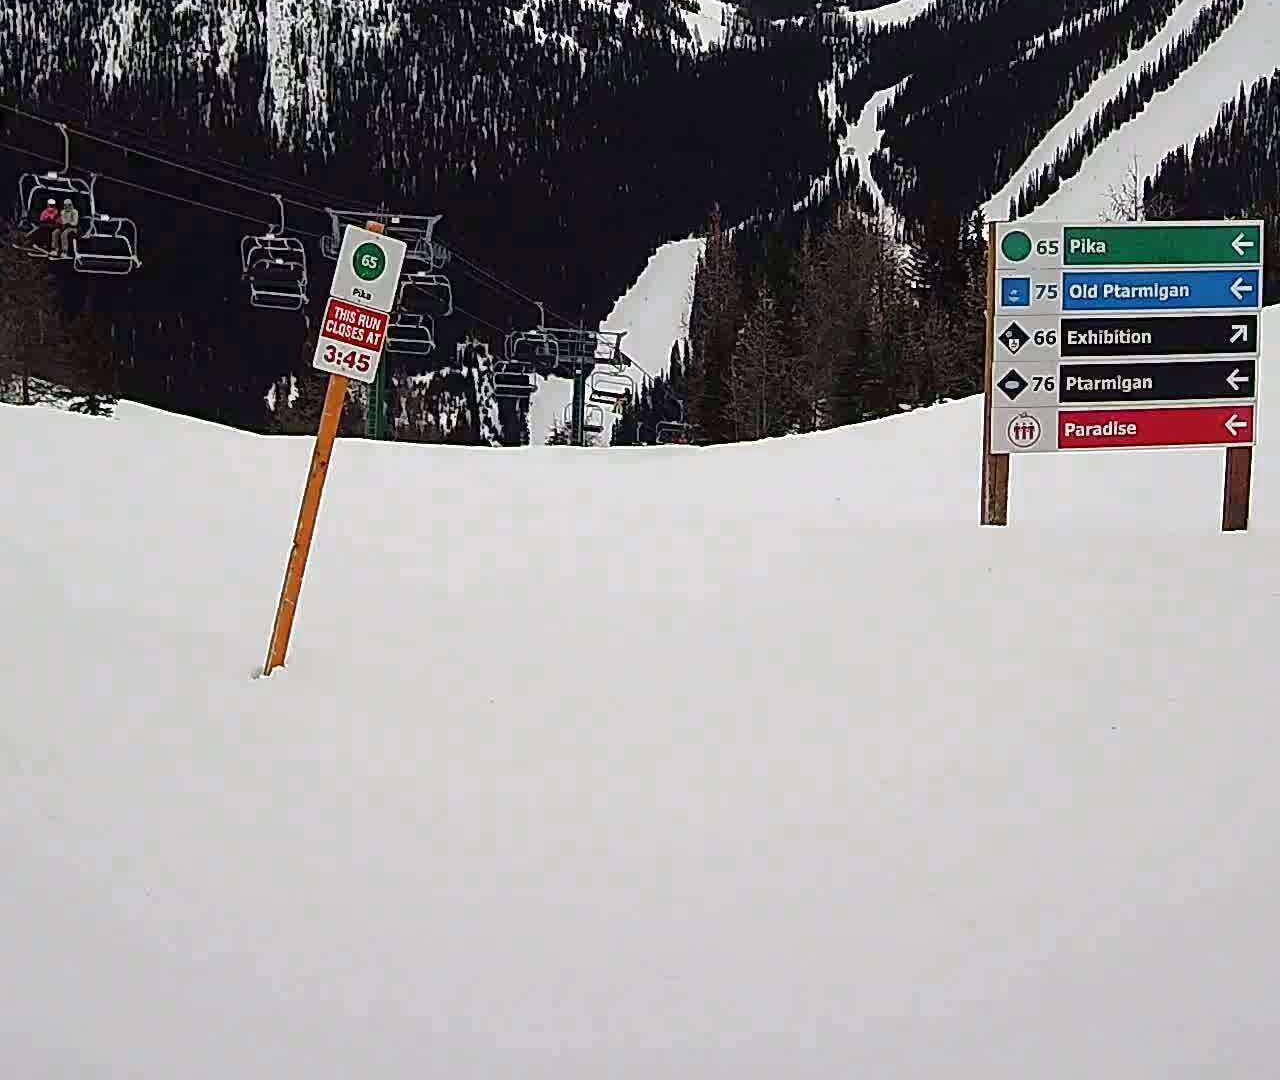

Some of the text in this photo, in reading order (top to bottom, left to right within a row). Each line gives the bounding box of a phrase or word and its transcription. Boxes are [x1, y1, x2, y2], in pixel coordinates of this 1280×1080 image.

[1035, 239, 1059, 256] 65
[1070, 238, 1107, 255] Pika
[361, 254, 379, 269] 65
[1035, 284, 1058, 300] 75
[1069, 282, 1190, 302] Old Ptarmigan
[334, 306, 382, 331] THIS RUN
[325, 320, 382, 346] CLOSES AT
[1033, 329, 1057, 346] 66
[1067, 327, 1152, 346] Exhibition
[323, 345, 372, 372] 3:45
[1032, 376, 1056, 392] 76
[1066, 374, 1153, 394] Ptarmigan
[1064, 420, 1138, 438] Paradise
